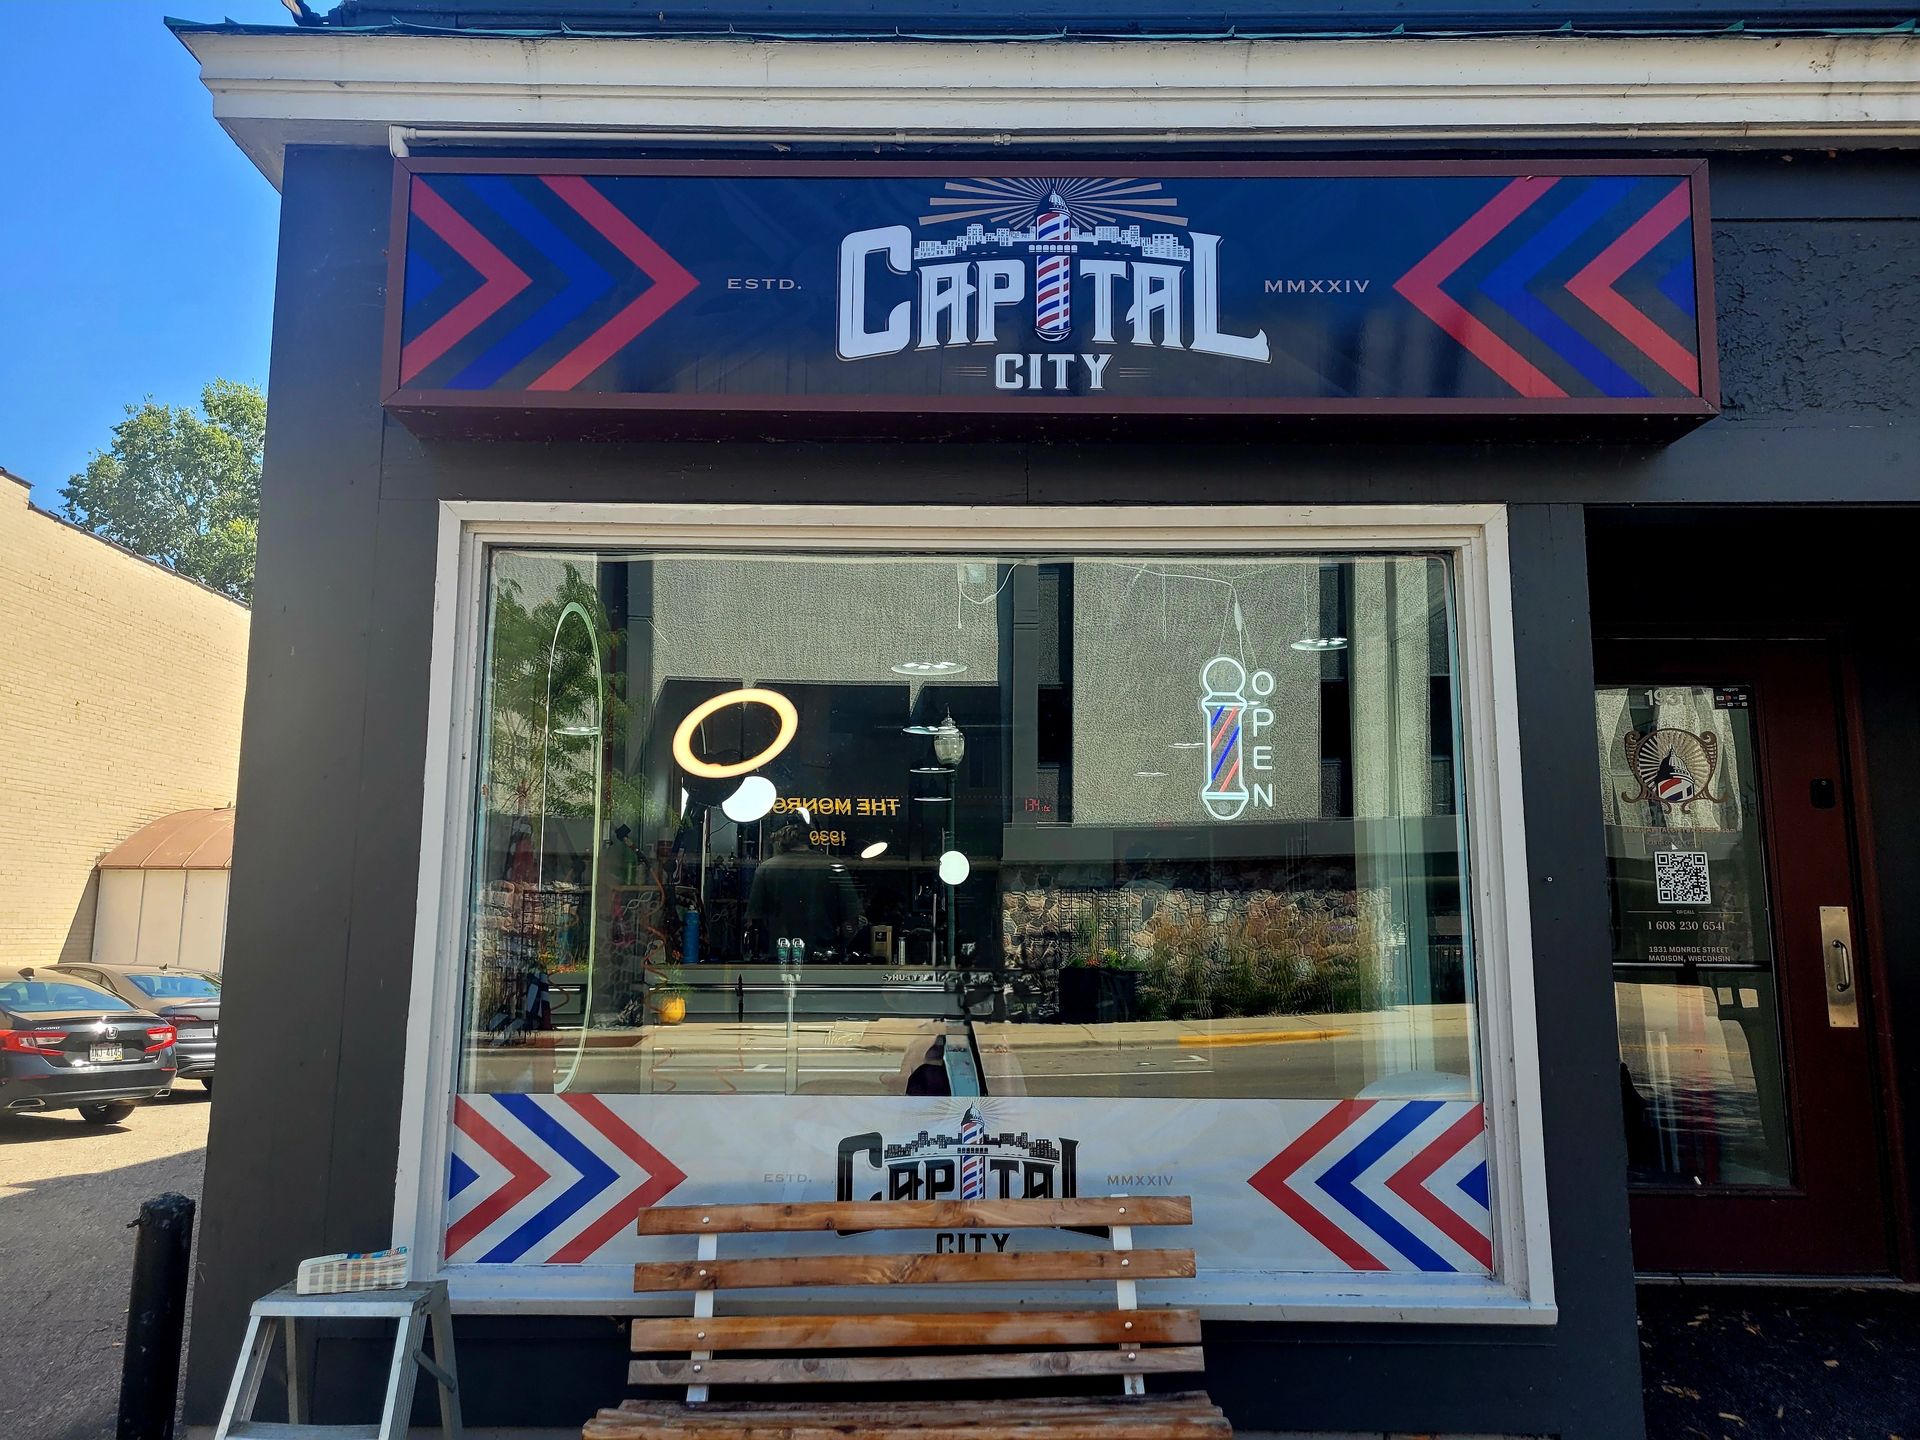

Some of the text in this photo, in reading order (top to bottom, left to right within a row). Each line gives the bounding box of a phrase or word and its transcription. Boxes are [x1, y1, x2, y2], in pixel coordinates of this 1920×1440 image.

[726, 277, 803, 291] ESTD.
[836, 216, 1272, 364] CAPITAL
[1263, 278, 1371, 294] MMXXIV
[994, 352, 1112, 391] CITY
[1251, 670, 1275, 808] OPEN
[1656, 920, 1676, 931] 608
[1679, 920, 1699, 931] 230
[1702, 920, 1726, 931] 6541
[763, 1172, 813, 1184] ESTD.
[1106, 1174, 1175, 1187] MMXXIV
[935, 1232, 1011, 1254] CITY
